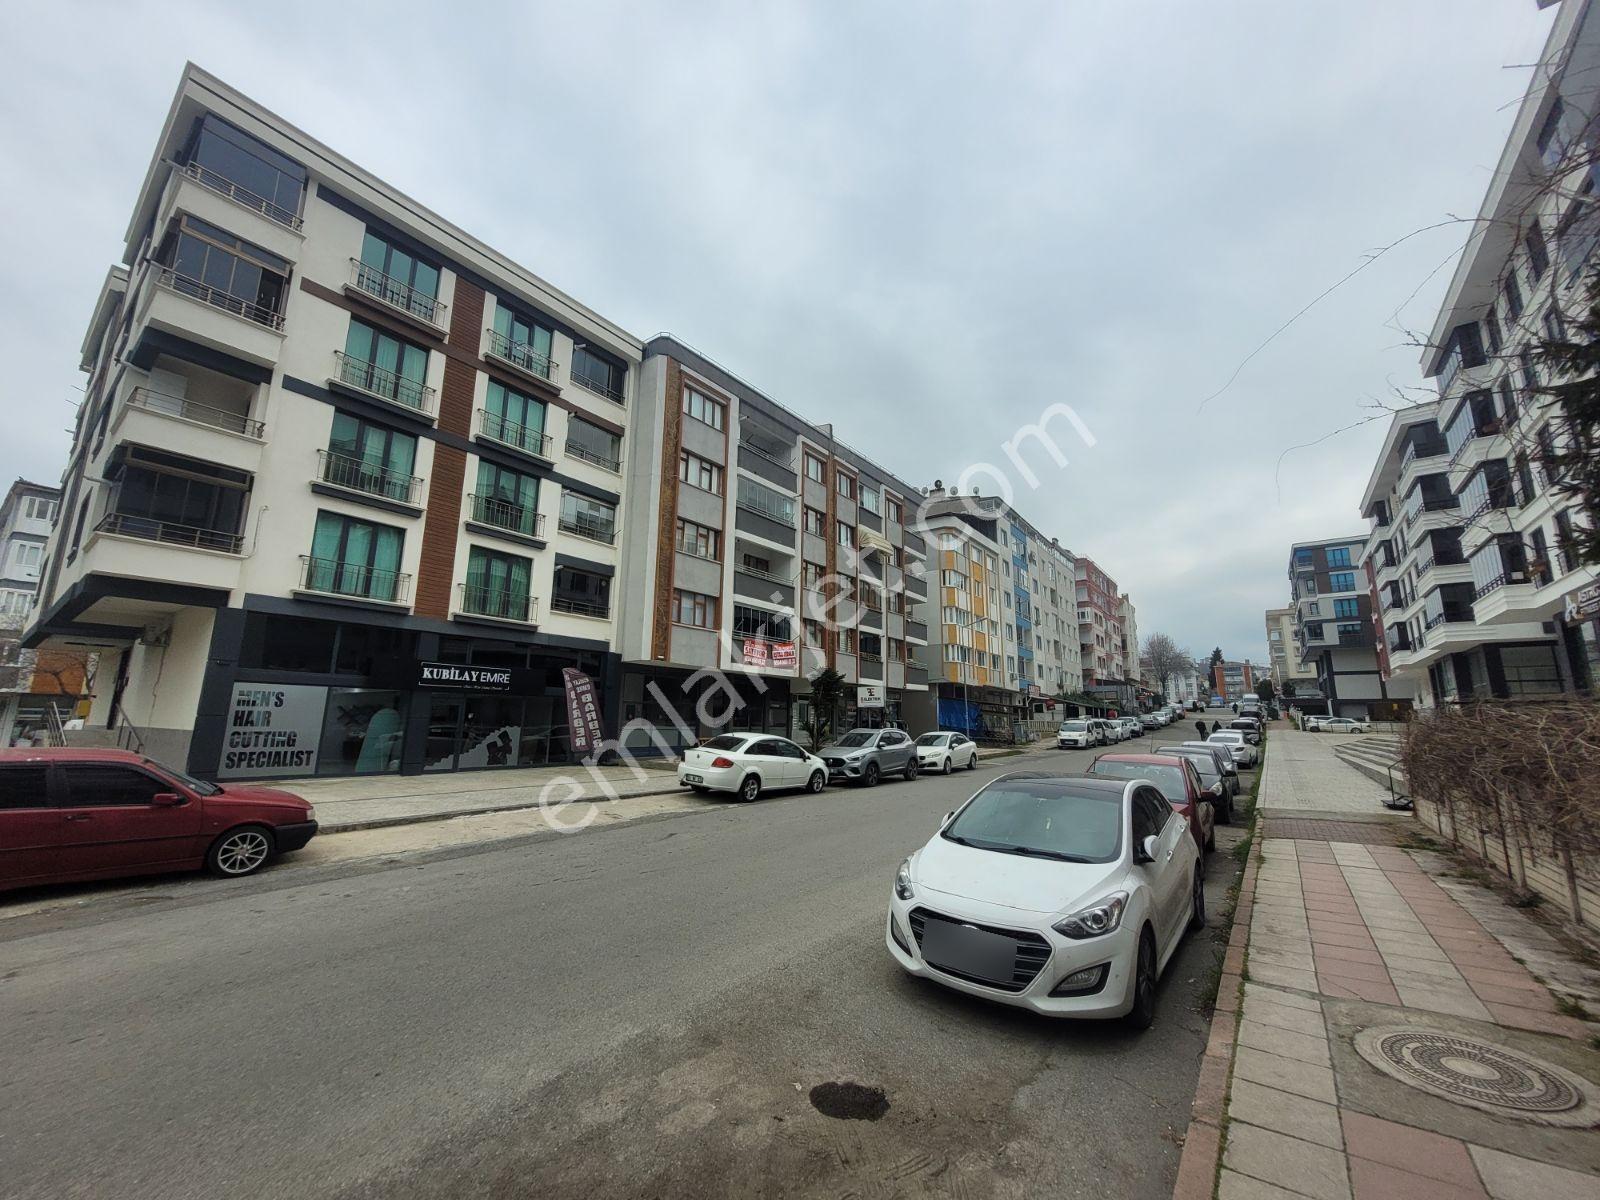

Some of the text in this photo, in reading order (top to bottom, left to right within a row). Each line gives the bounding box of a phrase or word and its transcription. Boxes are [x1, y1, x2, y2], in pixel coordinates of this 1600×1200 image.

[422, 667, 511, 684] KUBİLAY EMRE
[237, 690, 285, 708] MEN'S
[233, 710, 272, 727] HAIR
[229, 730, 297, 749] CUTTING
[225, 750, 313, 769] SPECIALIST
